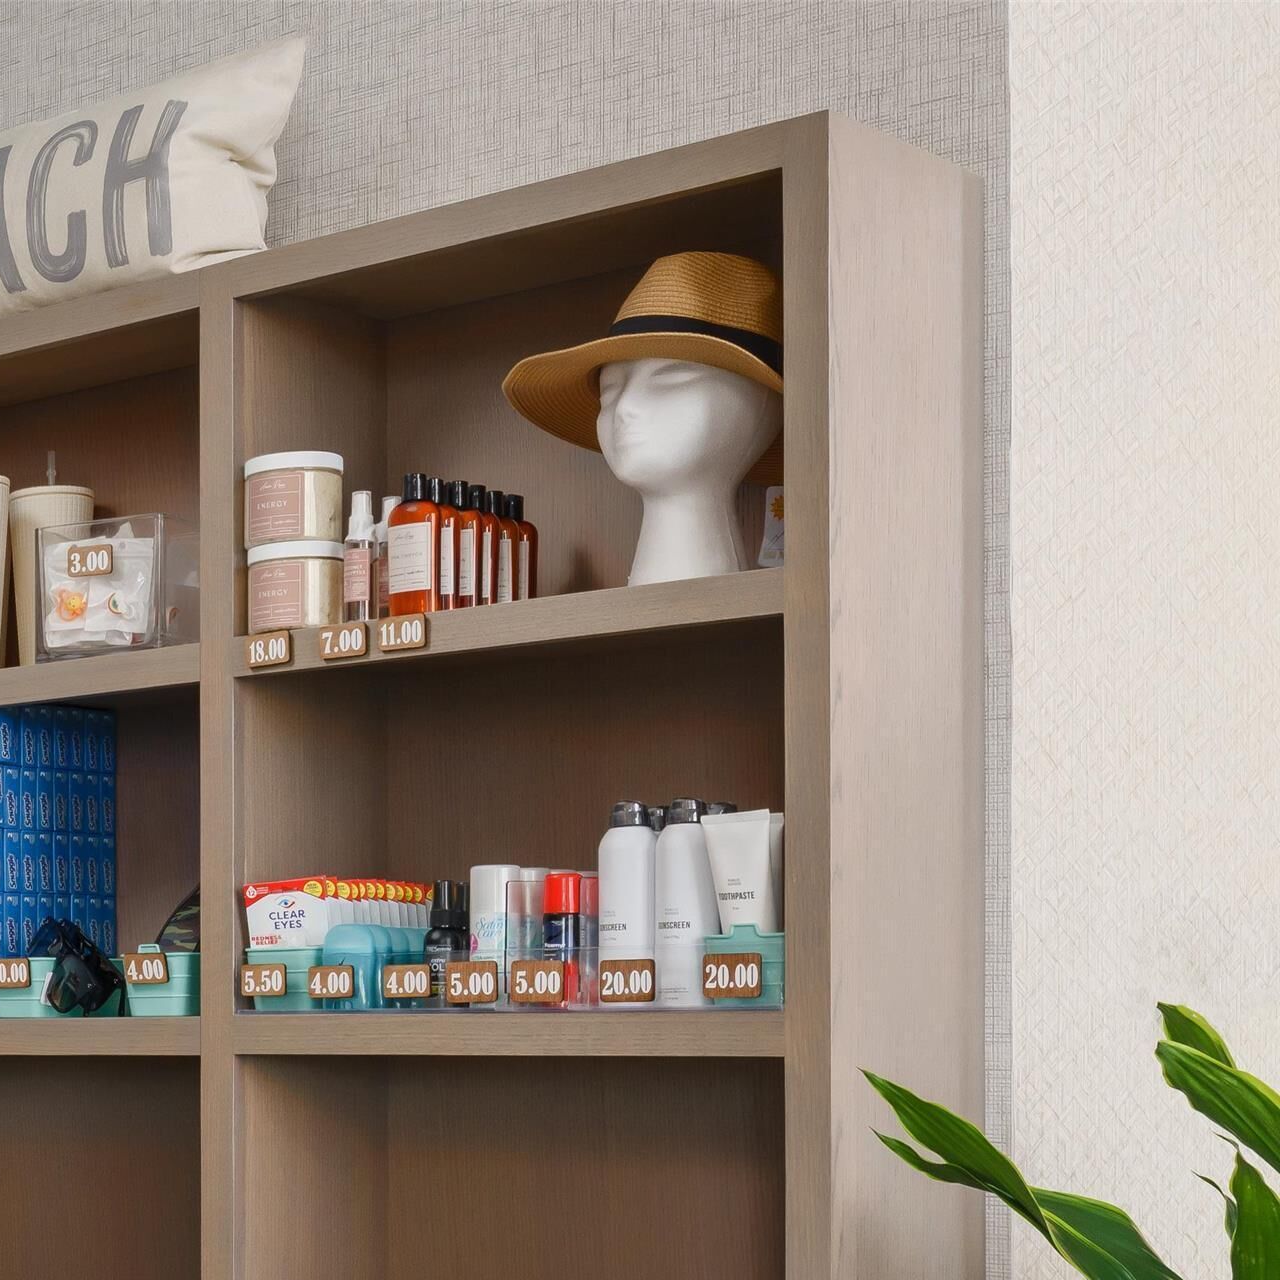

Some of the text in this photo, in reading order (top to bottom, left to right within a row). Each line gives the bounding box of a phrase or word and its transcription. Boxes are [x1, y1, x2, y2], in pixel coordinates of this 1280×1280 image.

[256, 499, 288, 511] ENERGY
[70, 550, 109, 573] 3.00
[321, 627, 363, 654] 7.00
[380, 619, 423, 646] 11.00
[249, 638, 286, 664] 18.00
[717, 889, 756, 902] TOOTHPASTE
[268, 909, 306, 921] CLEAR
[274, 920, 303, 930] EYES
[127, 959, 164, 981] 4.00
[244, 969, 283, 993] 5.50
[386, 970, 427, 994] 4.00
[601, 969, 652, 995] 20.00
[704, 963, 759, 989] 20.00
[310, 971, 350, 994] 4.00
[450, 971, 494, 996] 5.00
[515, 970, 561, 995] 5.00
